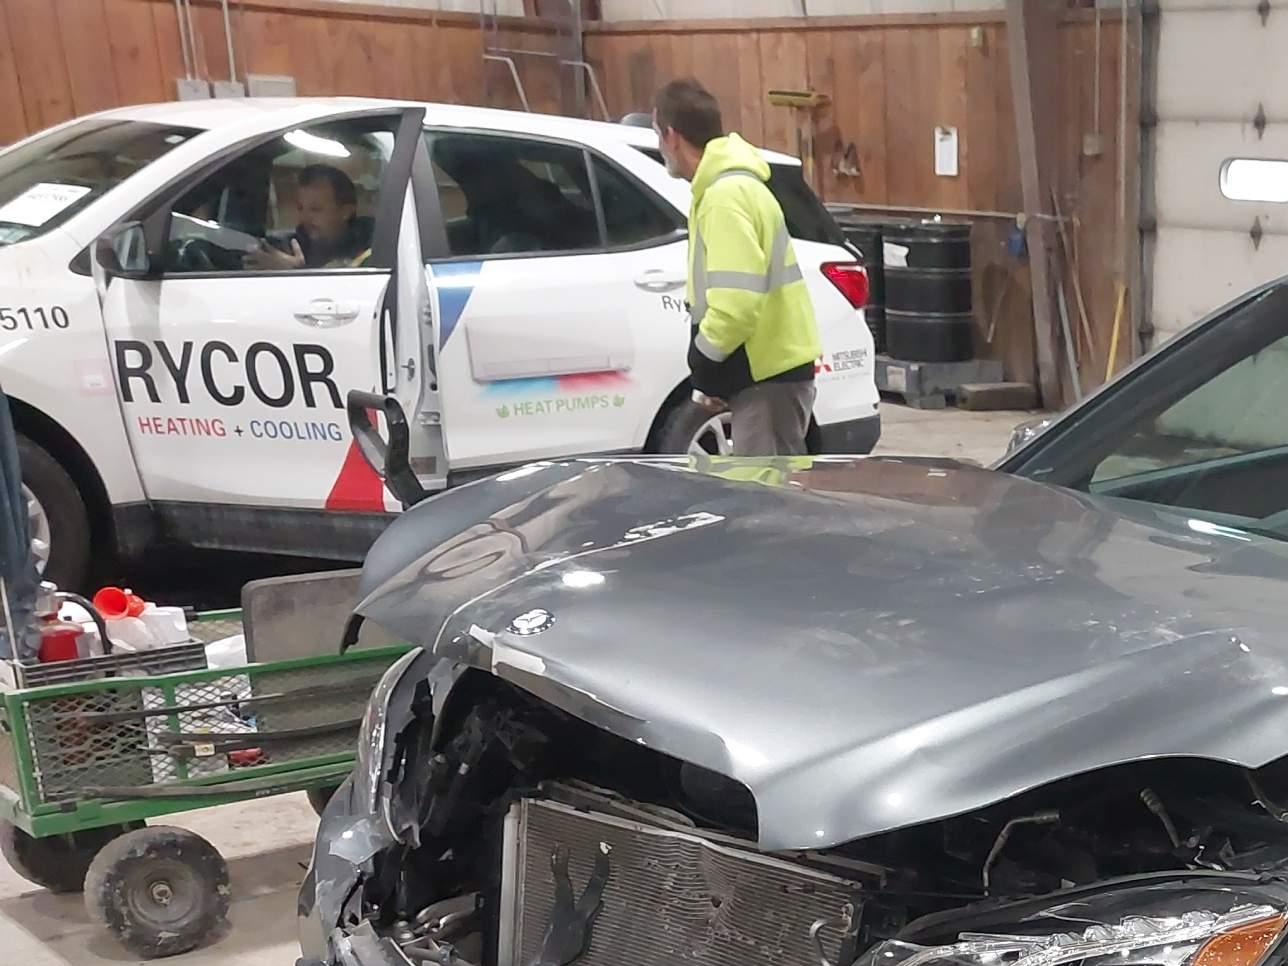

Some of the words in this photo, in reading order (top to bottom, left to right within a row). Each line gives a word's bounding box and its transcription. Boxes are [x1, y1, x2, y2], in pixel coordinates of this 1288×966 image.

[116, 340, 344, 409] RYCOR
[513, 400, 553, 416] HEAT
[555, 395, 609, 412] PUMPS
[138, 417, 226, 437] HEATING
[233, 426, 244, 437] +
[250, 420, 343, 441] COOLING
